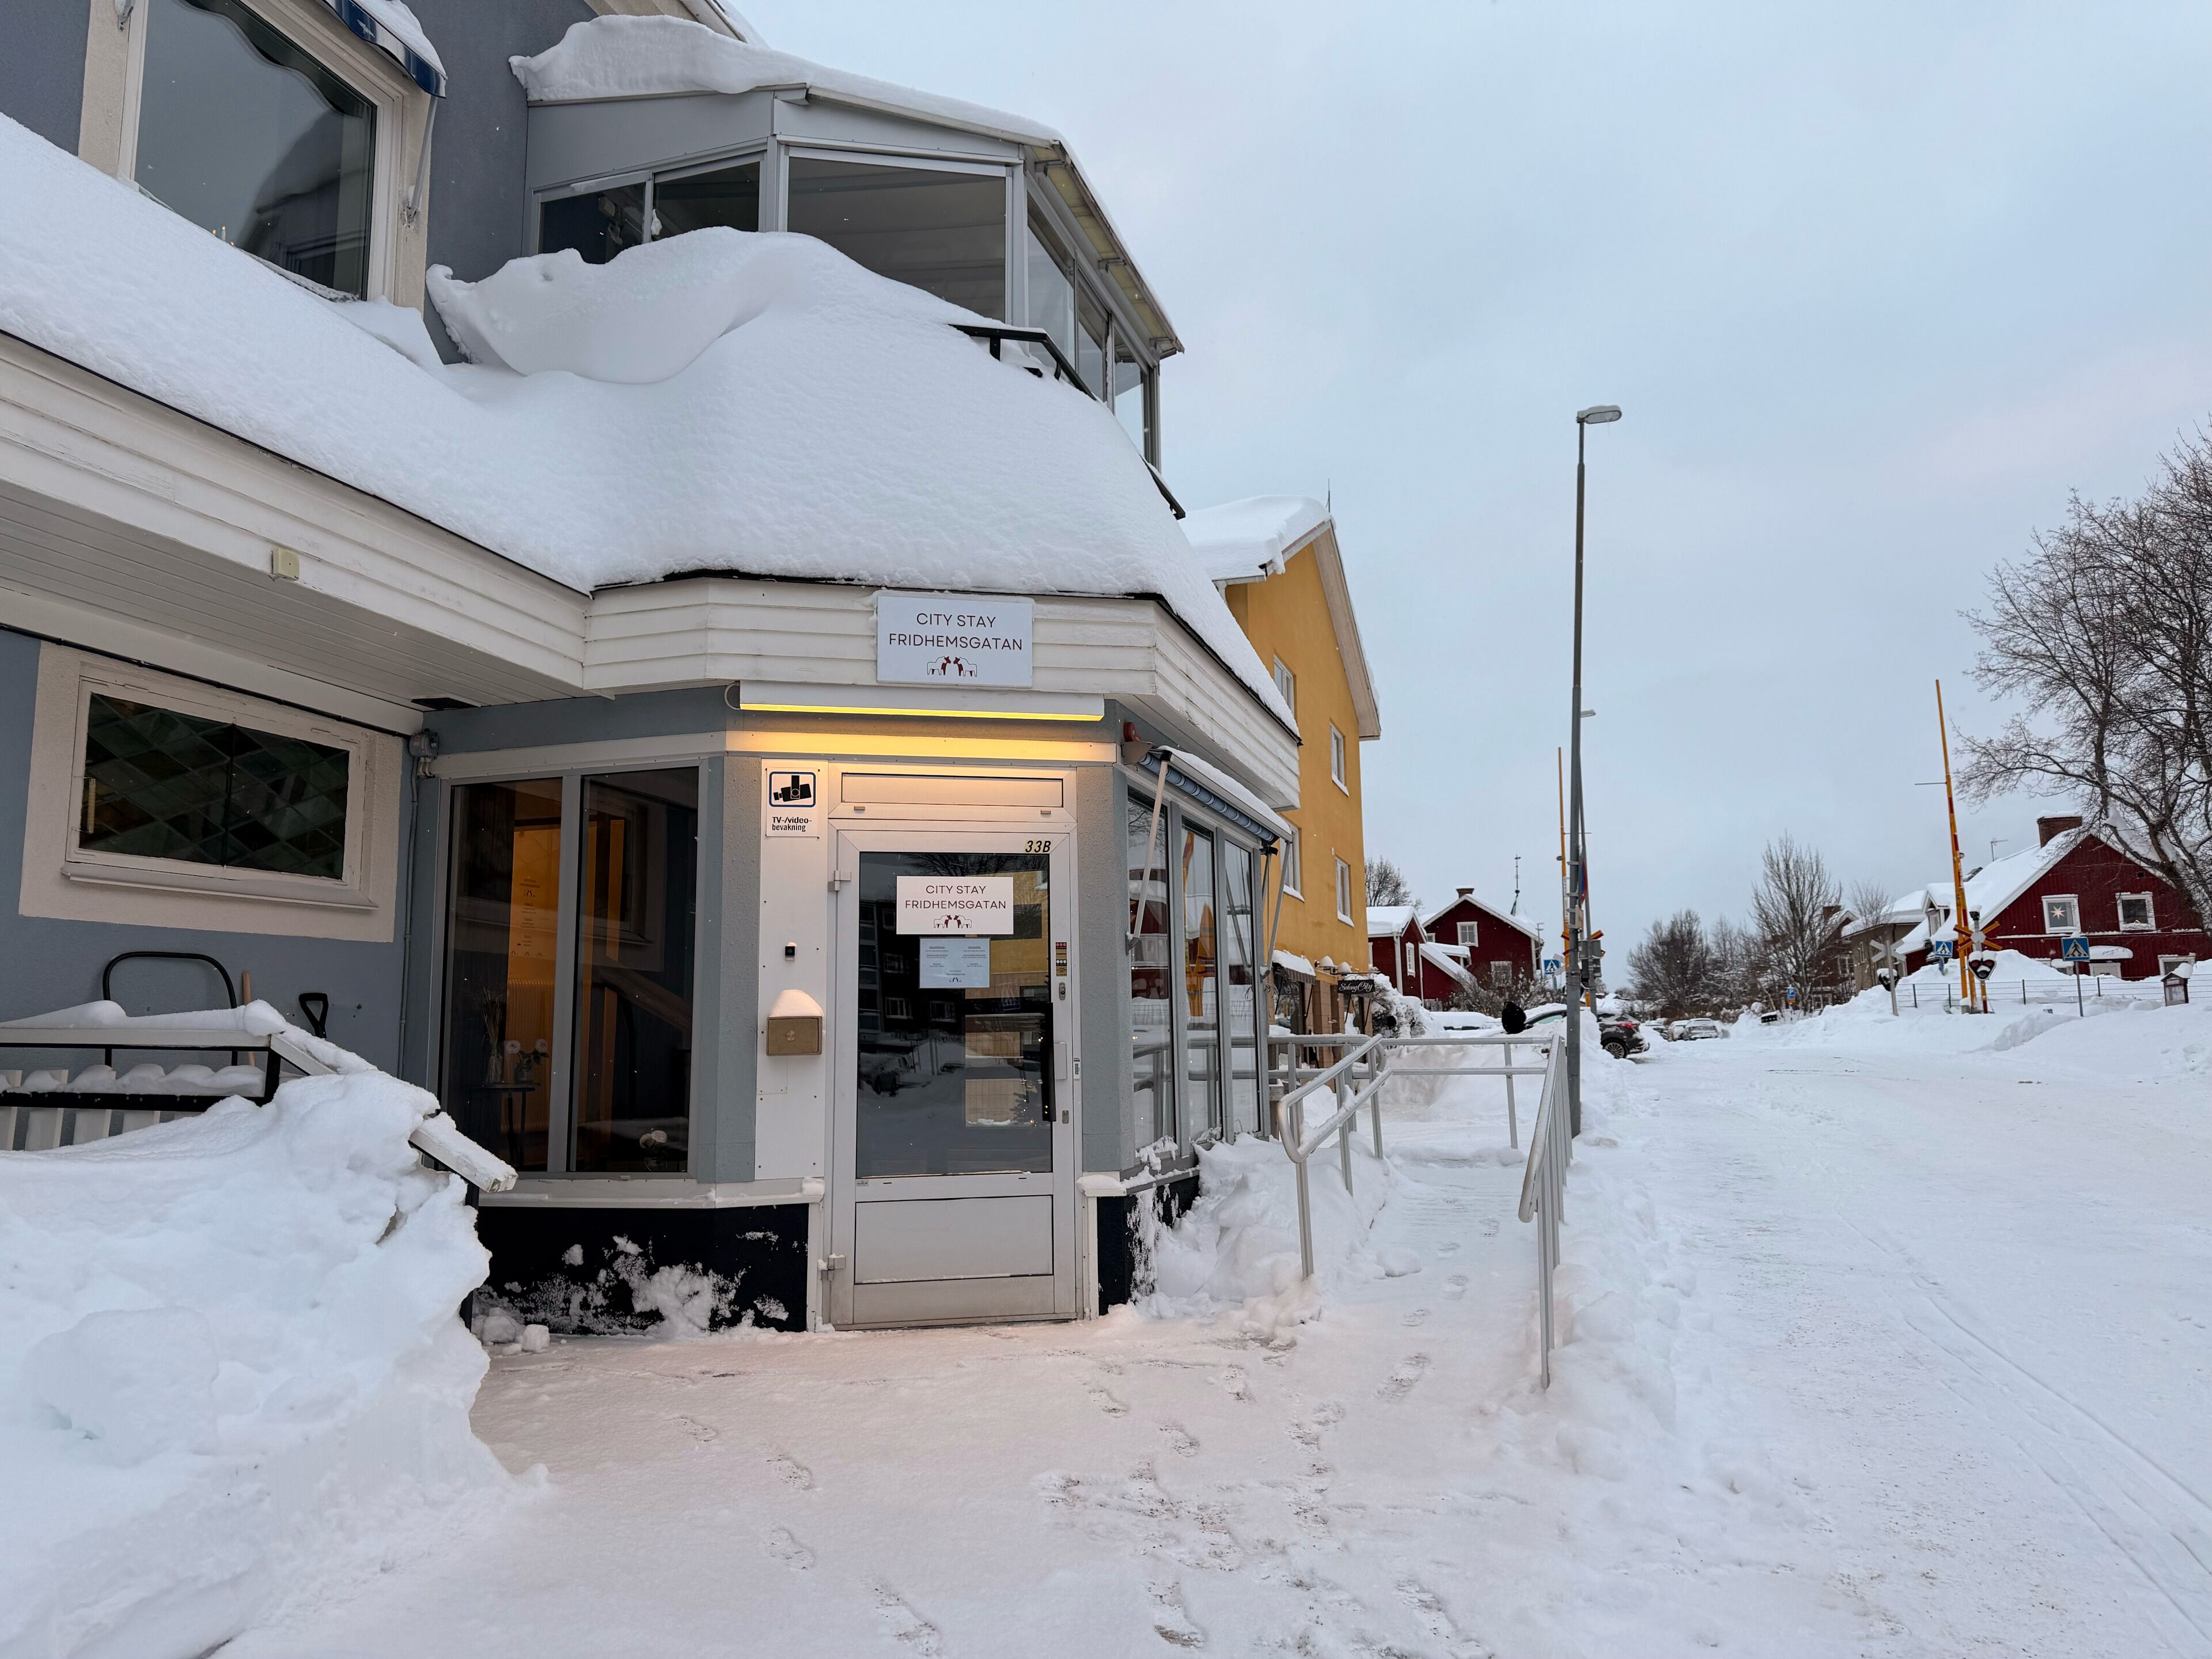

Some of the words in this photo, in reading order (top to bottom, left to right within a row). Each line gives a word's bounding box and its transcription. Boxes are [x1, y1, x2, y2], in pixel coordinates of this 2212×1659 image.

[916, 613, 952, 626] CITY
[957, 615, 996, 628] STAY
[889, 633, 1022, 650] FRIDHEMSGATAN
[772, 824, 806, 832] bevakning
[1025, 840, 1051, 853] 33B
[926, 885, 953, 894] CITY
[956, 885, 986, 894] STAY
[905, 900, 1006, 909] FRIDHEMSGATAN
